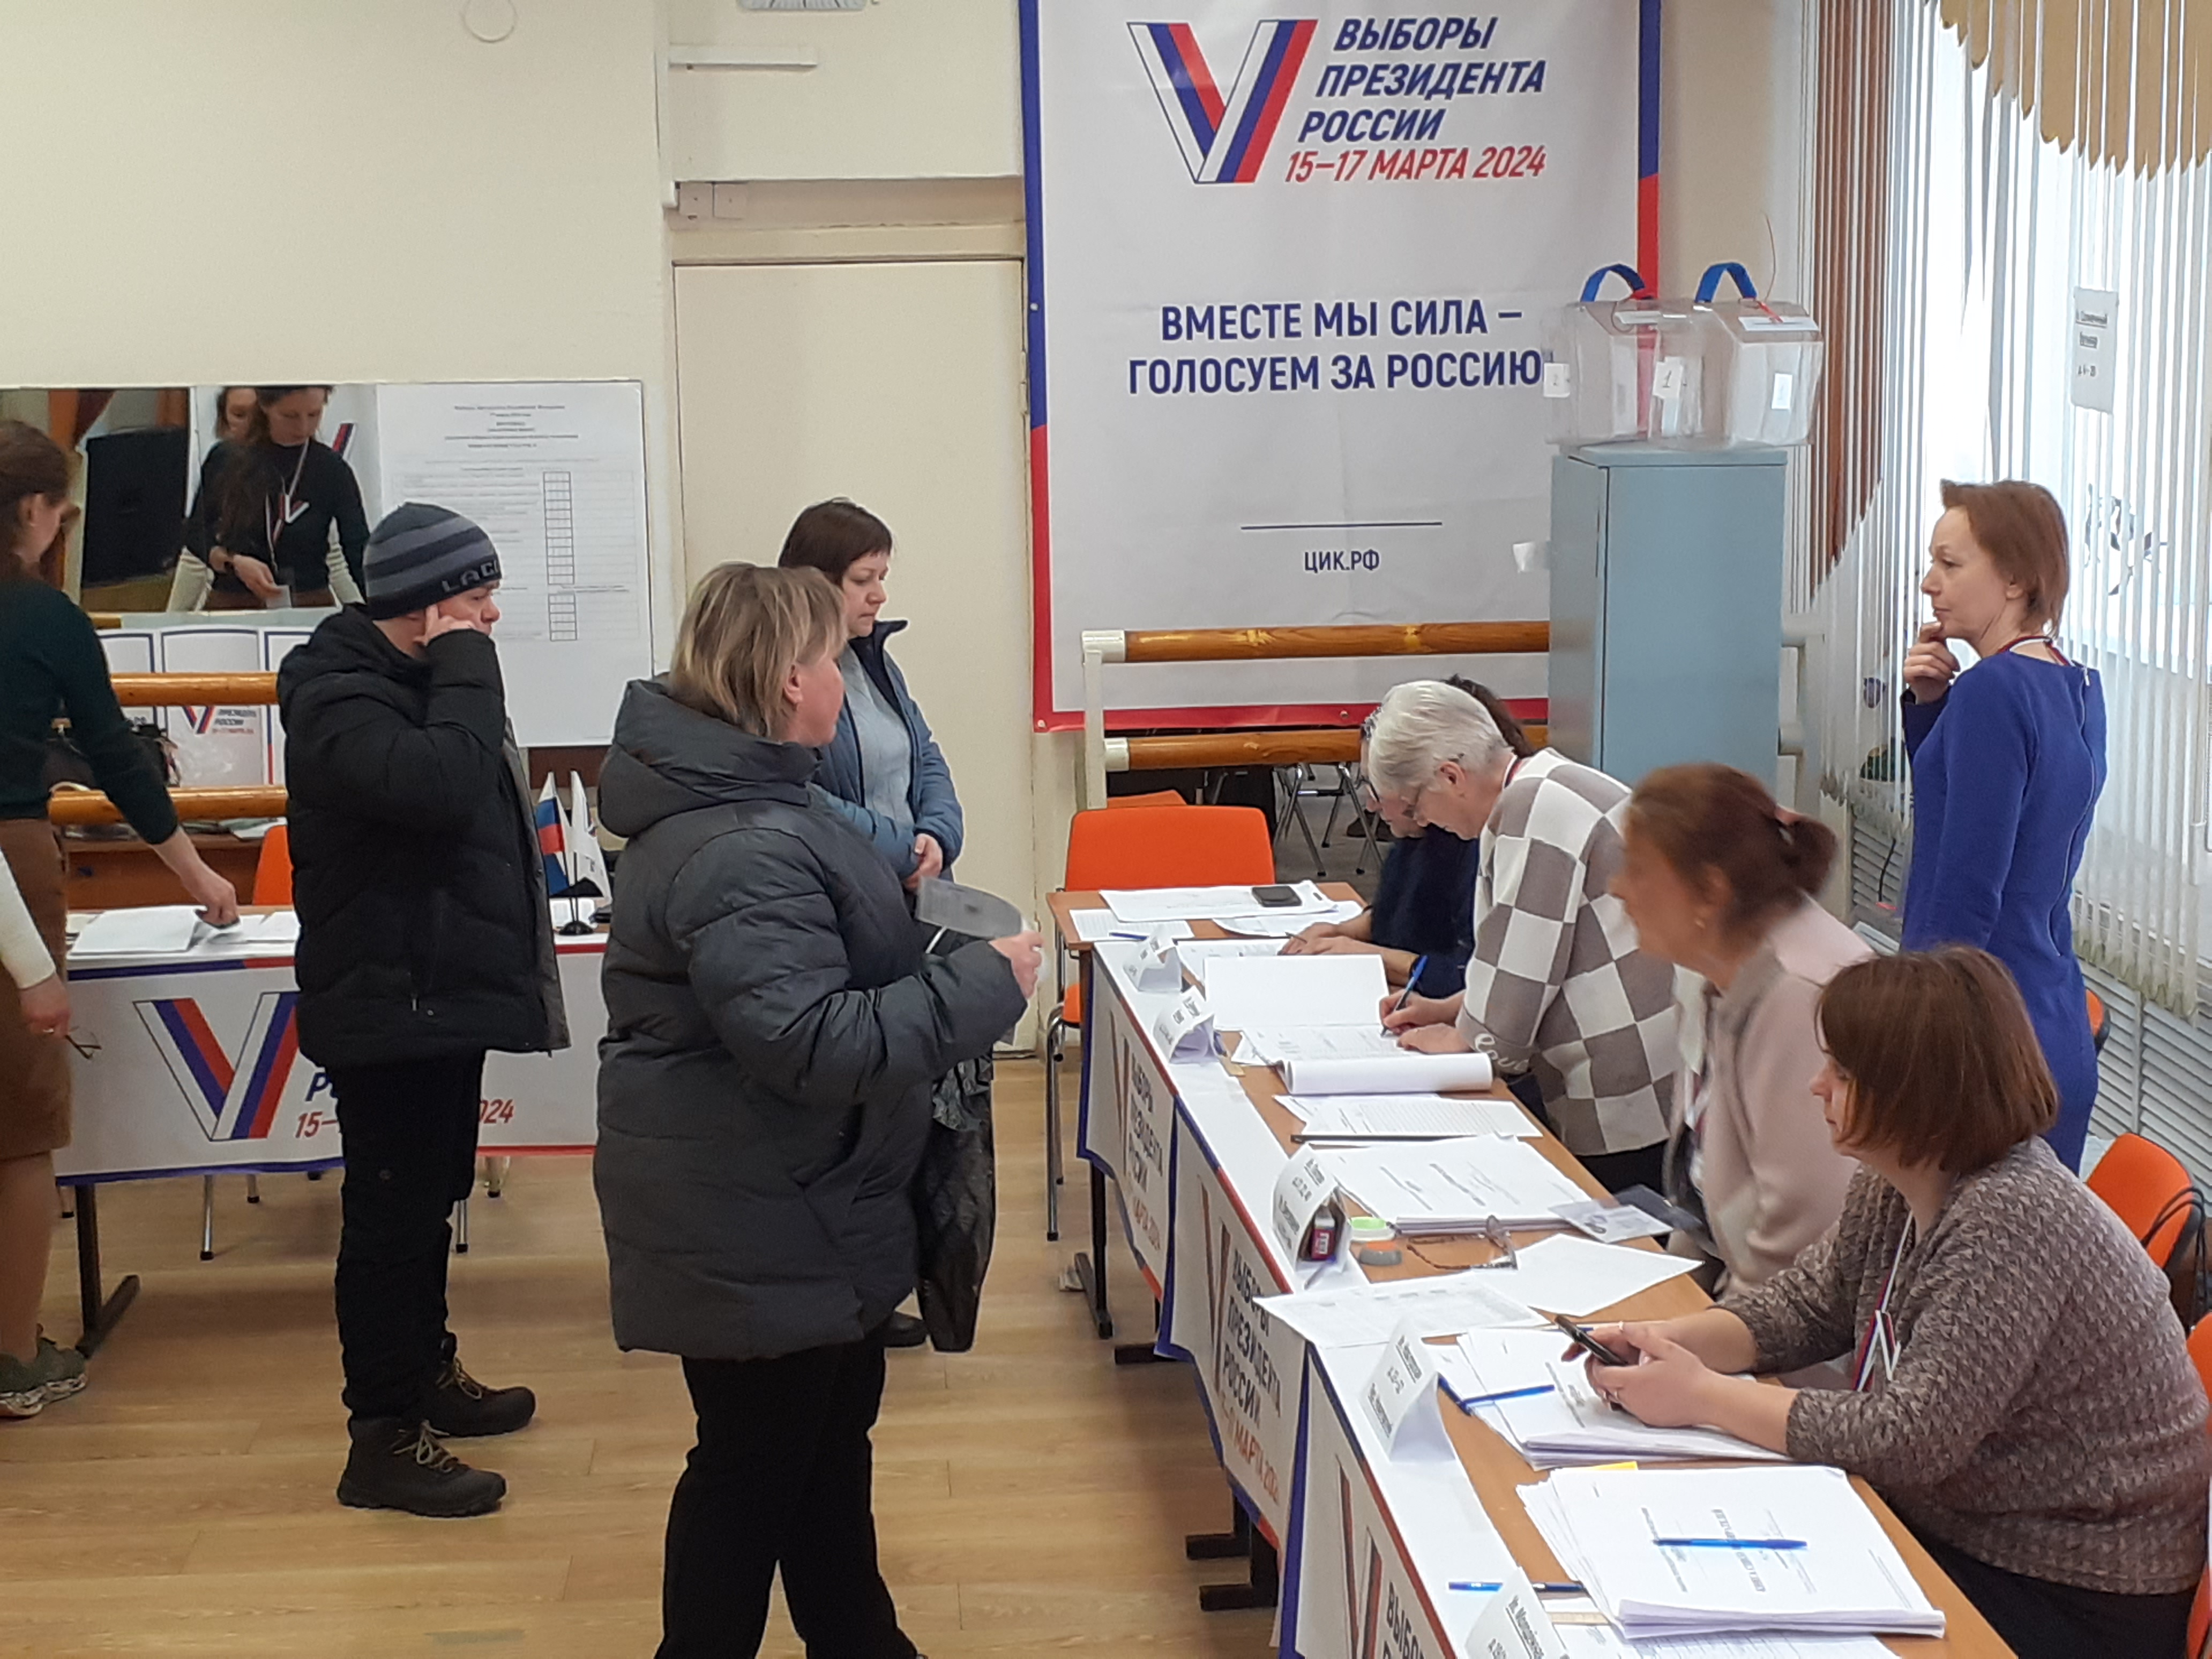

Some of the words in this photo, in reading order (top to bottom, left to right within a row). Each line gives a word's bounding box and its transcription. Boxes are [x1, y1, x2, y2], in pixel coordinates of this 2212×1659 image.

[1334, 18, 1497, 50] ВЫБОРЫ
[1316, 61, 1546, 100] ПРЕЗИДЕНТА
[1299, 109, 1445, 142] РОССИИ
[1368, 148, 1469, 180] МАРТА
[1472, 145, 1546, 179] 2024
[1162, 303, 1302, 341] ВМЕСТЕ
[1314, 302, 1379, 337] МЫ
[1391, 299, 1488, 335] СИЛА
[1129, 356, 1320, 394] ГОЛОСУЕМ
[1331, 355, 1376, 390] ЗА
[1304, 549, 1380, 573] ЦИК.РФ
